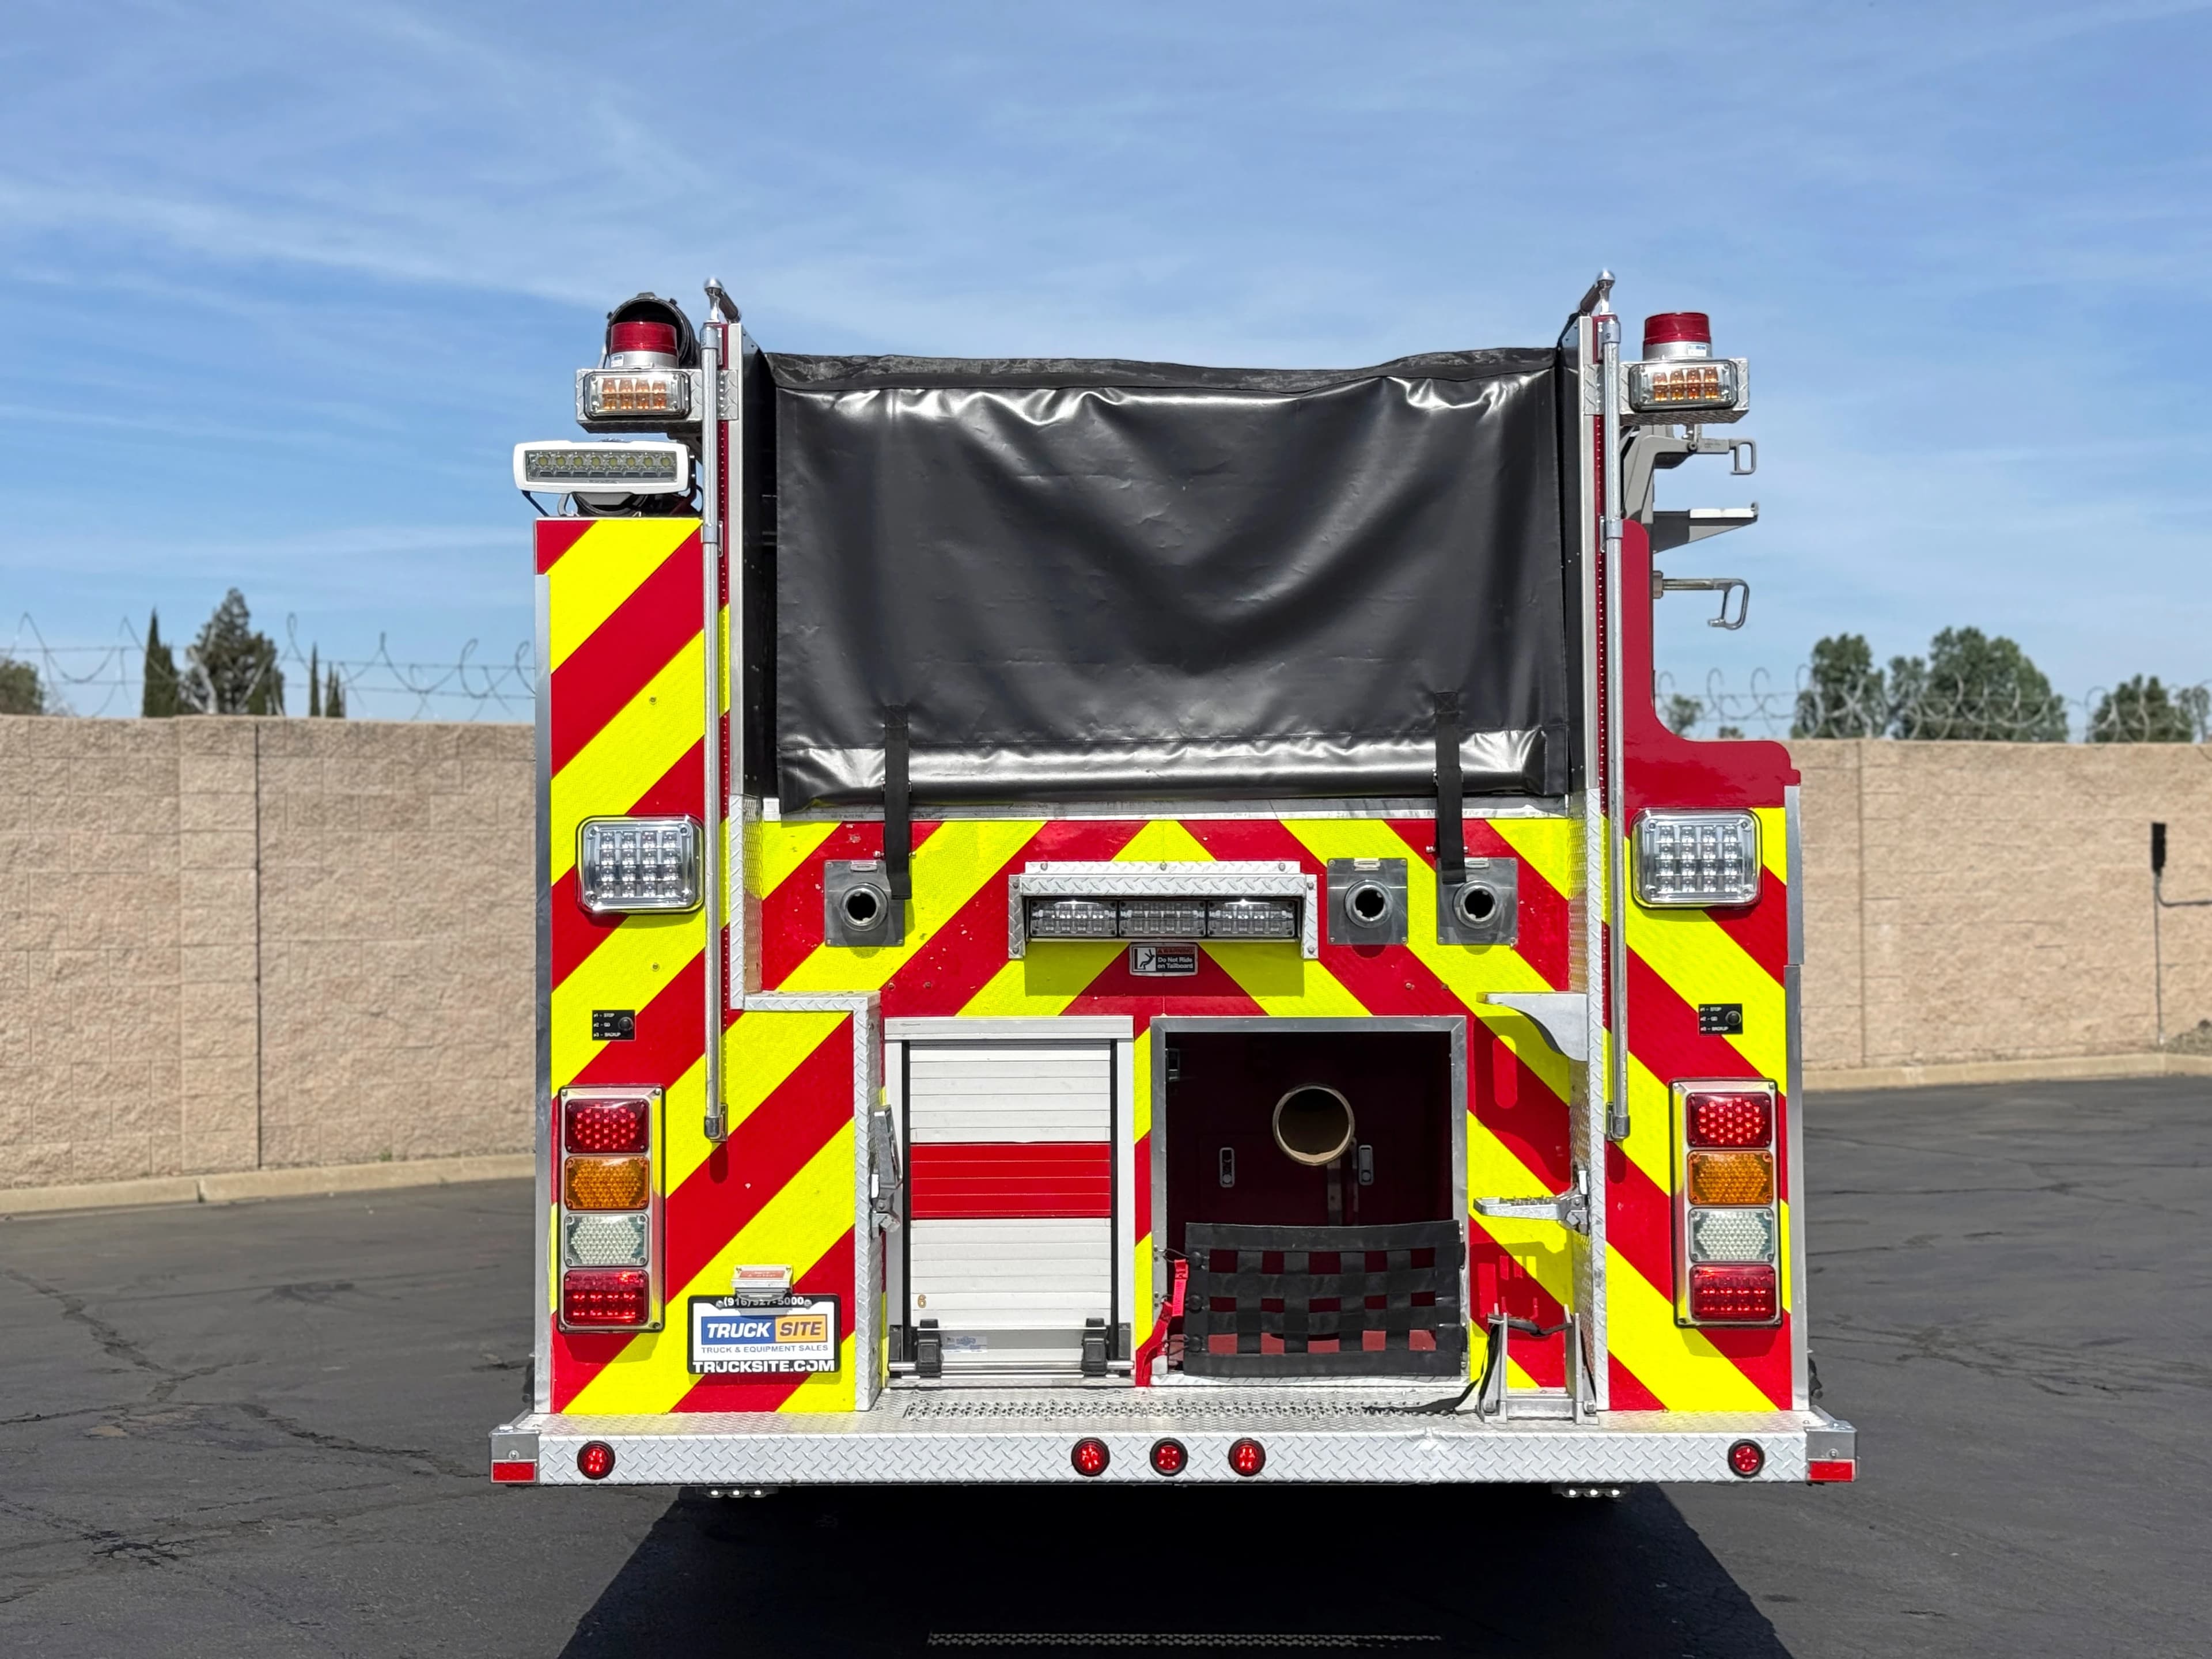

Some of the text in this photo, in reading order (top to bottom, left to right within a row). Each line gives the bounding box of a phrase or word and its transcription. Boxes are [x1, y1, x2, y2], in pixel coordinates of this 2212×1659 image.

[918, 1294, 926, 1309] 6
[707, 1321, 823, 1338] TRUCK SITE
[693, 1360, 835, 1373] TRUCKSITE.COM
